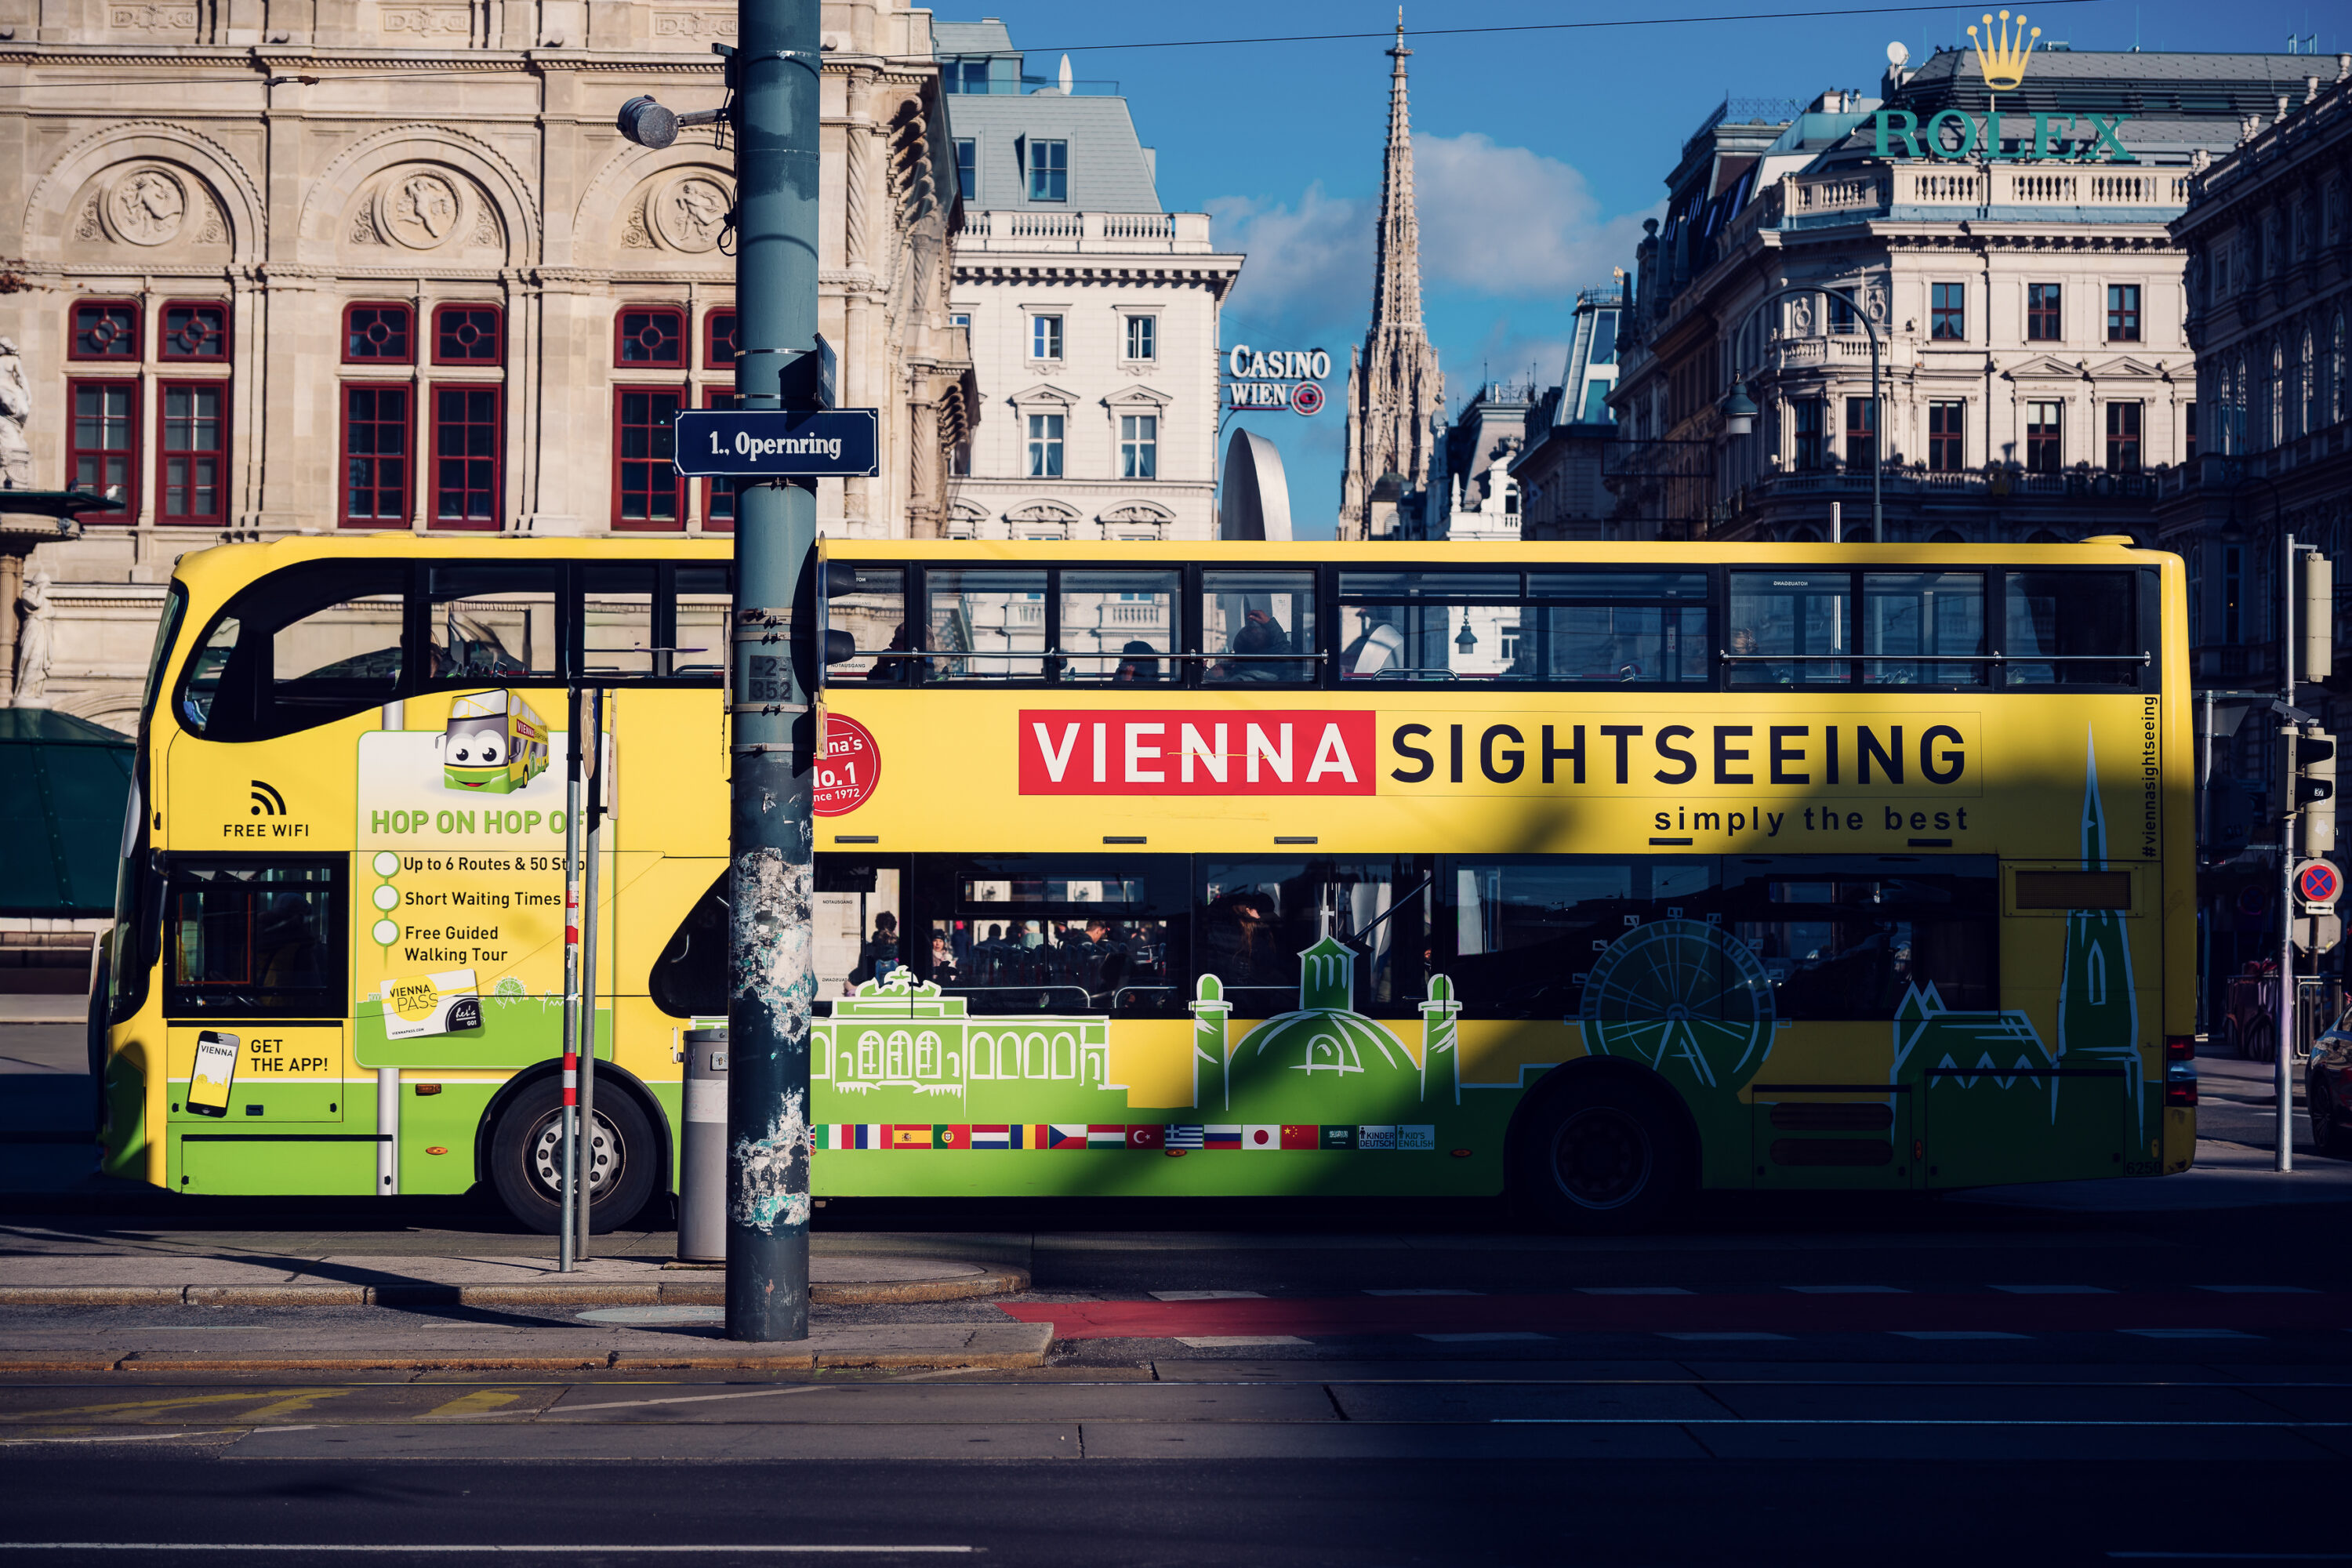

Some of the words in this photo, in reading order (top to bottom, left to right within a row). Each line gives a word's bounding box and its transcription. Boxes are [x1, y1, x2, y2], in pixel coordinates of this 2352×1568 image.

[1869, 109, 2136, 161] ROLEX
[1229, 344, 1331, 379] CASINO
[1229, 383, 1287, 406] WIEN
[710, 431, 730, 456] 1.,
[735, 431, 842, 462] Opernring
[753, 681, 791, 700] 352
[1032, 722, 1359, 782] VIENNA
[1390, 723, 1965, 785] SIGHTSEEING
[2140, 695, 2159, 858] #viennasightseeing
[813, 793, 833, 802] nce
[835, 788, 860, 800] 1972
[223, 824, 266, 837] FREE
[272, 824, 309, 837] WIFI
[372, 810, 429, 833] HOP
[436, 810, 474, 833] ON
[484, 810, 541, 833] HOP
[1654, 806, 1784, 837] simply
[1804, 807, 1864, 831] the
[1885, 806, 1968, 831] best
[404, 857, 423, 873] Up
[427, 858, 441, 870] to
[445, 858, 454, 870] 6
[459, 858, 510, 870] Routes
[515, 858, 525, 870] &
[530, 858, 547, 870] 50
[405, 891, 448, 906] Short
[452, 891, 510, 909] Waiting
[514, 891, 561, 906] Times
[405, 926, 441, 939] Free
[445, 926, 499, 939] Guided
[405, 947, 467, 964] Walking
[472, 947, 508, 961] Tour
[390, 984, 431, 998] VIENNA
[397, 993, 439, 1013] PASS
[391, 1027, 424, 1036] VIENNAPASS.COM
[201, 1045, 234, 1058] VIENNA
[251, 1040, 283, 1053] GET
[251, 1058, 284, 1072] THE
[289, 1058, 328, 1072] APP!
